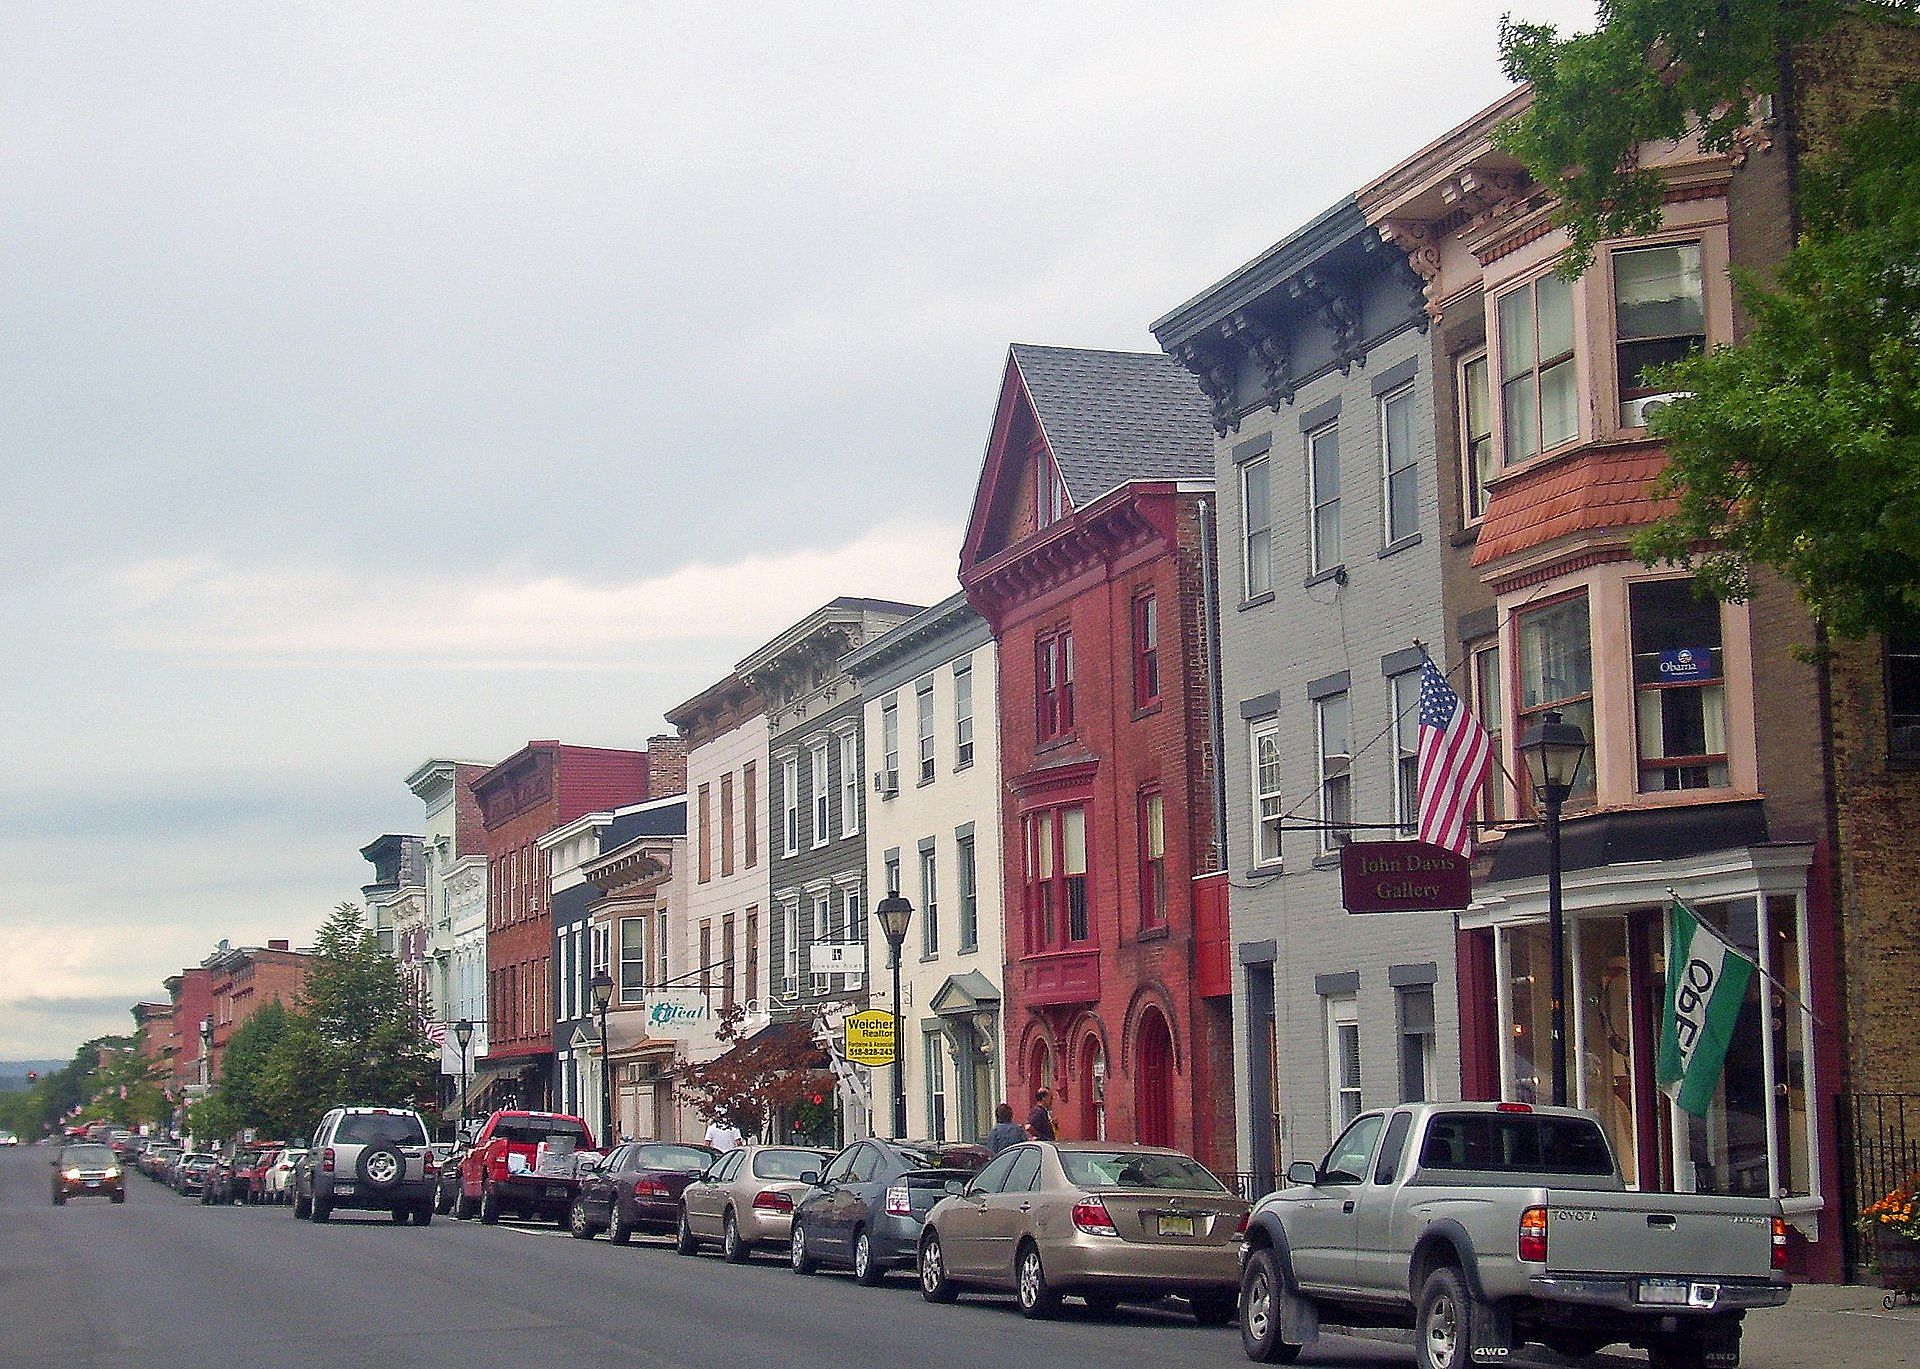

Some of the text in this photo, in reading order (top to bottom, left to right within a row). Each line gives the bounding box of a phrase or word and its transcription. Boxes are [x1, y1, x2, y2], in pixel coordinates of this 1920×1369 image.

[1660, 661, 1698, 672] Obama
[1359, 855, 1455, 876] John Davis
[1376, 882, 1441, 899] Gallery
[848, 1019, 894, 1029] Weicher
[1552, 1210, 1598, 1221] TOYOTA
[1474, 1347, 1509, 1356] 4WD
[1705, 1352, 1737, 1361] 4WD
